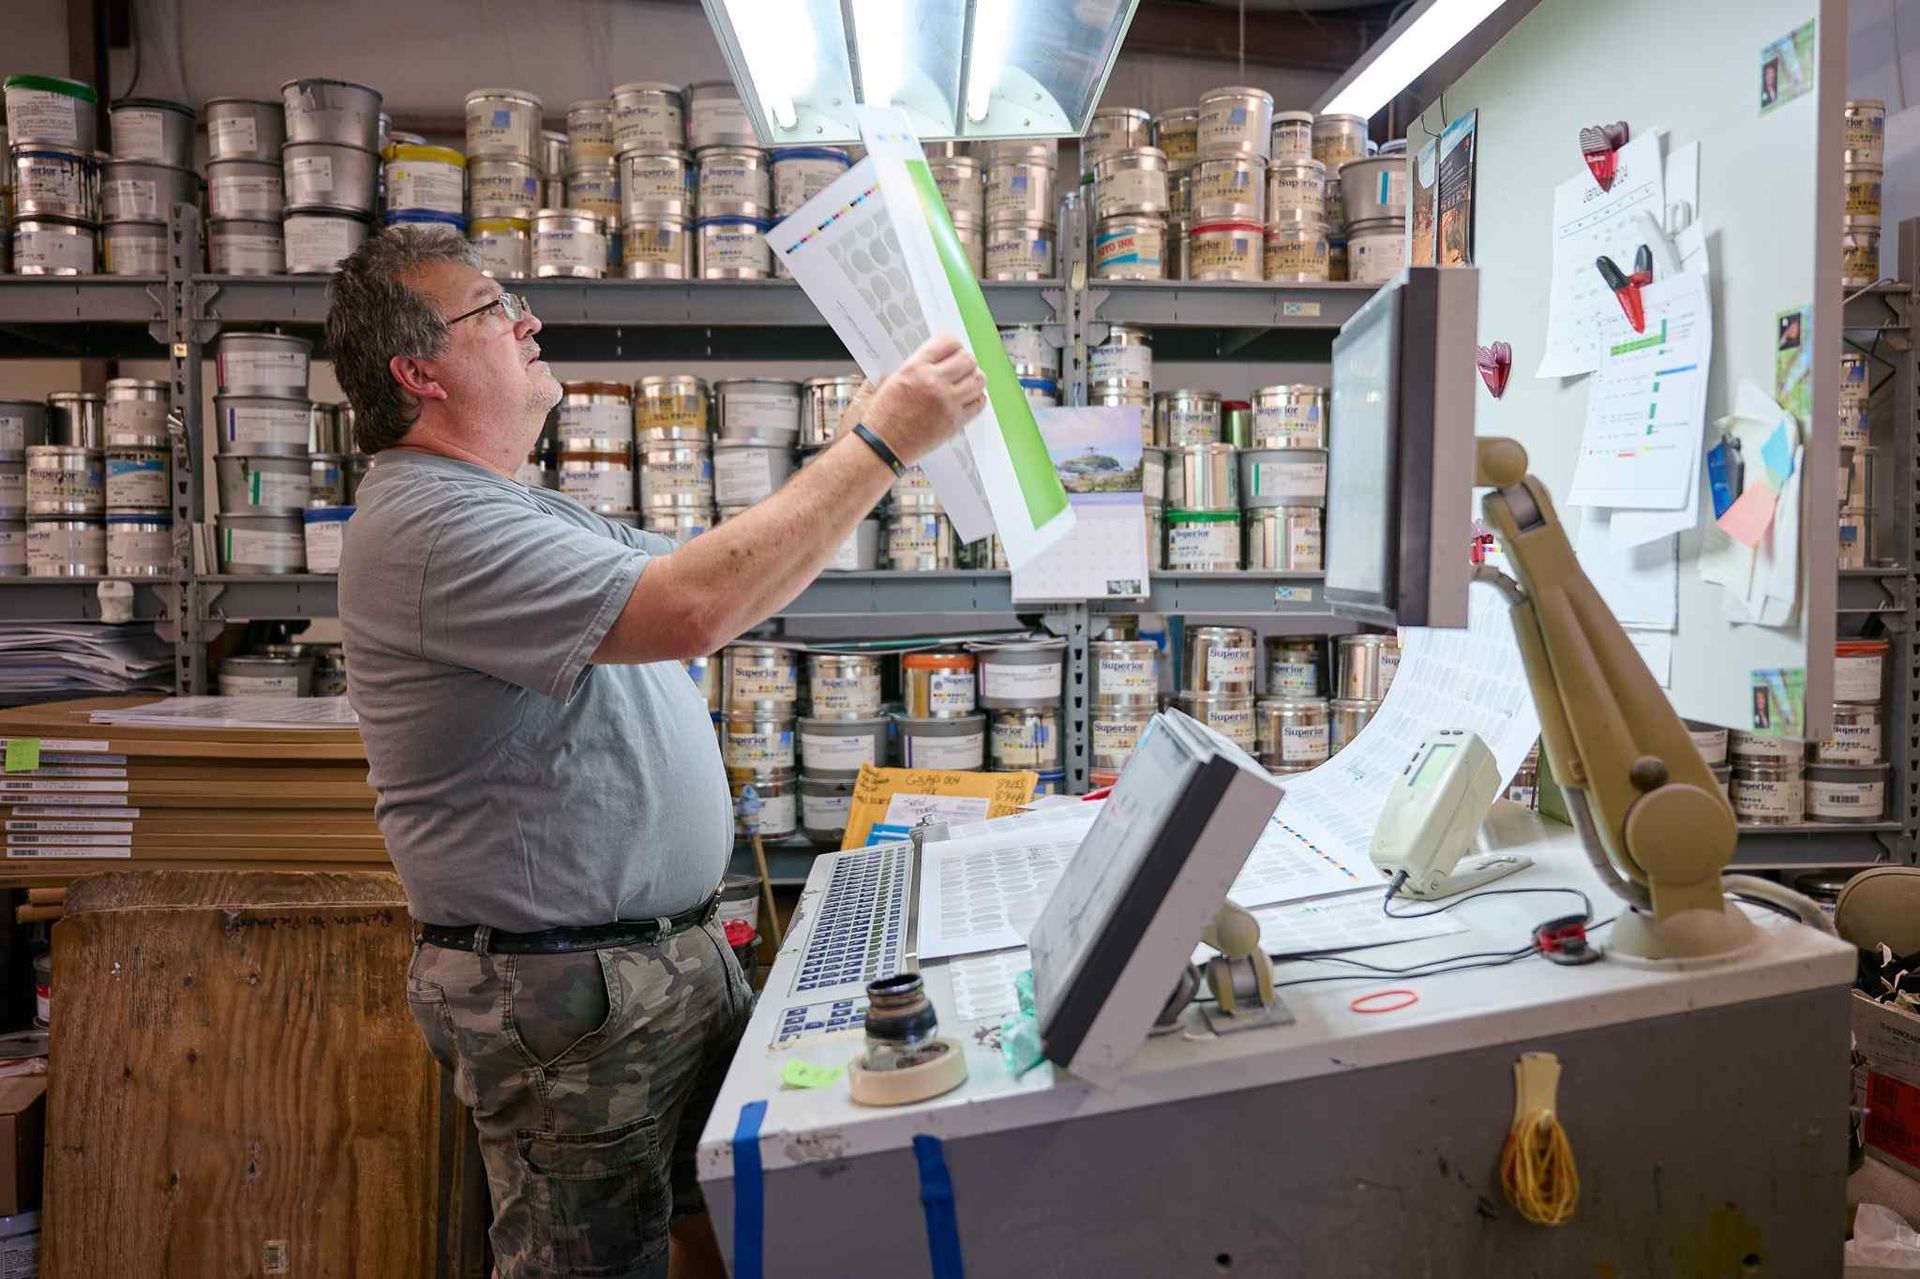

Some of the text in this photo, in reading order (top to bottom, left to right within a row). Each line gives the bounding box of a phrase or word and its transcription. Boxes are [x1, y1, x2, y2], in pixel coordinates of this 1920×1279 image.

[29, 468, 78, 480] Superior
[1174, 529, 1210, 539] Superior
[1208, 648, 1251, 659] Superior
[1100, 660, 1145, 672] Superior
[734, 667, 780, 679] Superior
[821, 679, 860, 689] Superior
[1210, 711, 1250, 722] Superior
[1094, 722, 1138, 735] Superior
[1284, 726, 1325, 738] Superior
